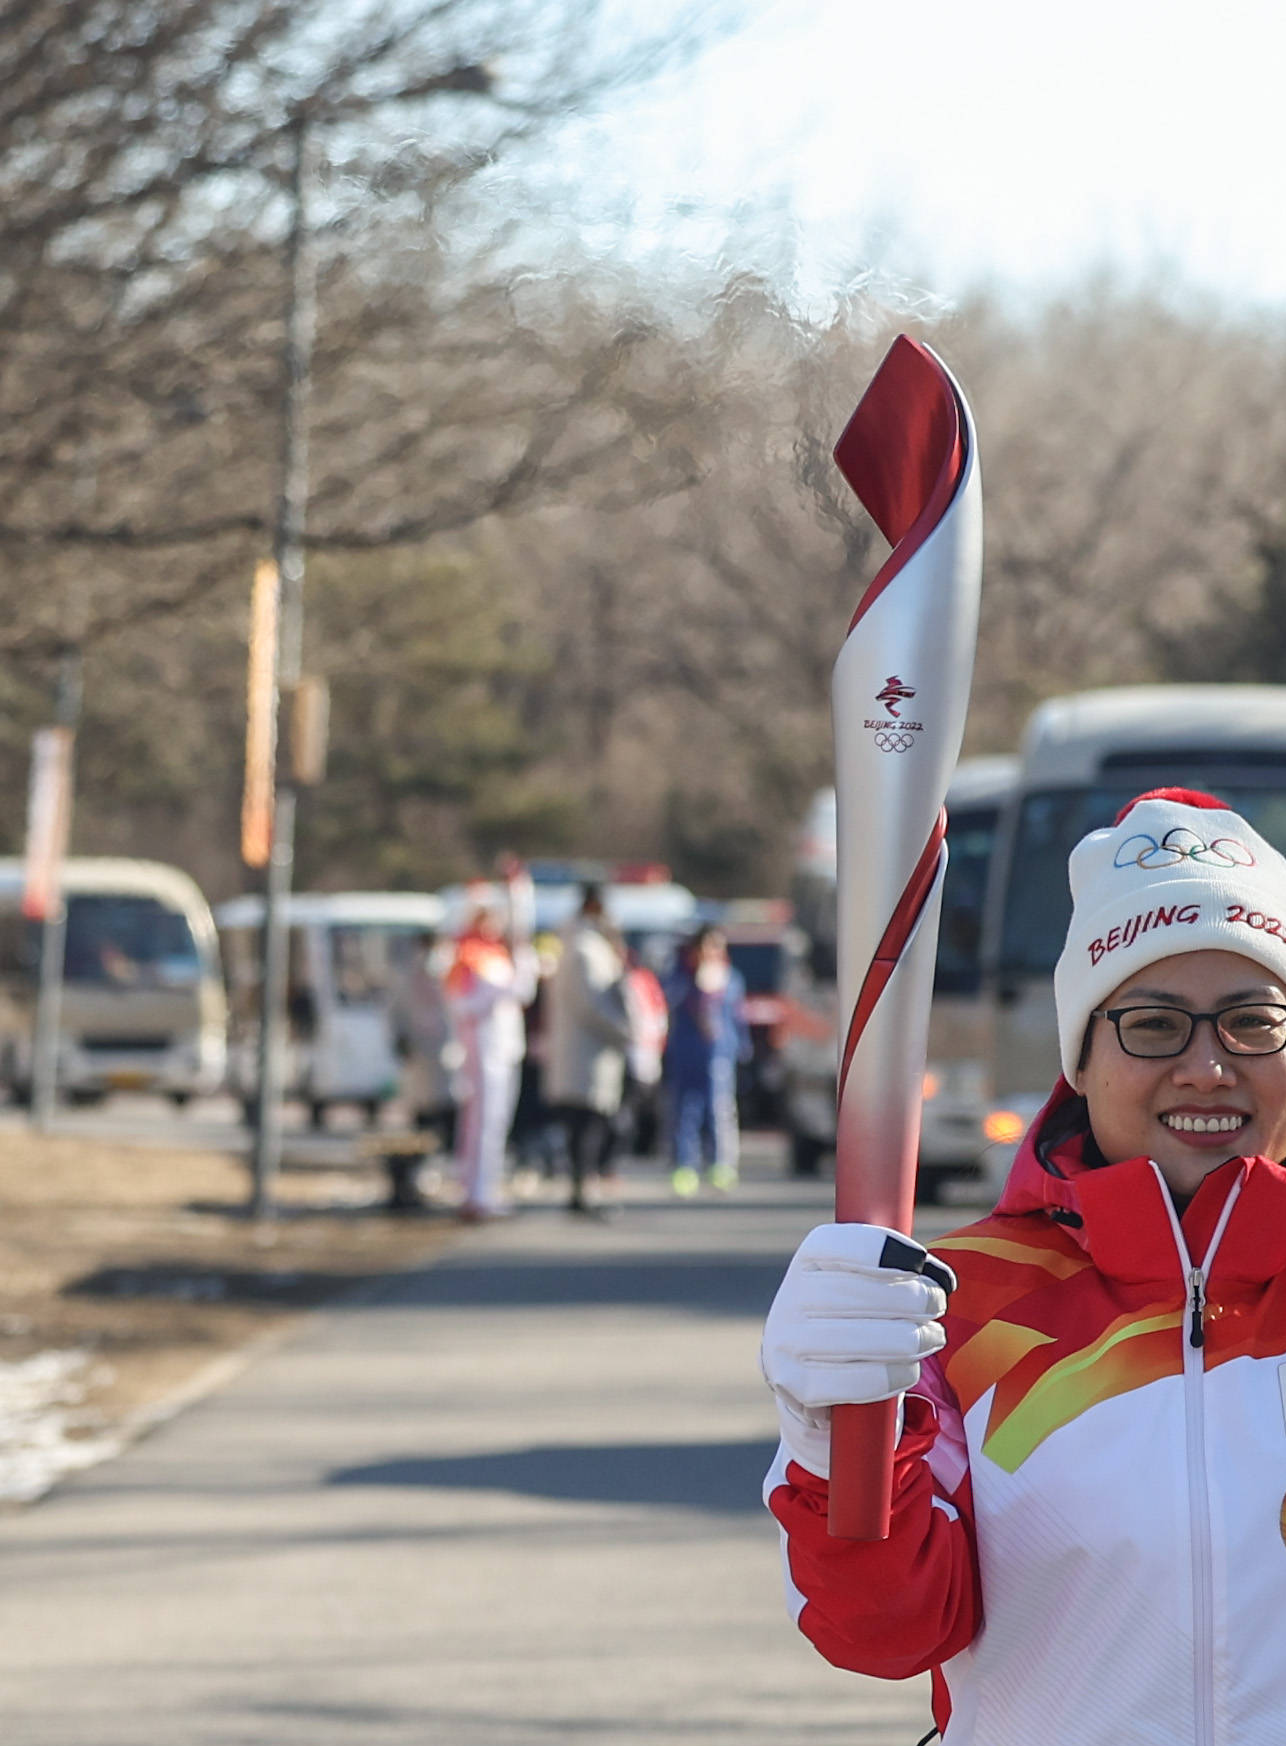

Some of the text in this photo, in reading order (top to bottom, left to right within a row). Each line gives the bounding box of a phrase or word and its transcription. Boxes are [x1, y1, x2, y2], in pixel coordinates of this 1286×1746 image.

[864, 720, 924, 731] BEIJING 2022
[1087, 904, 1201, 966] BEIJING
